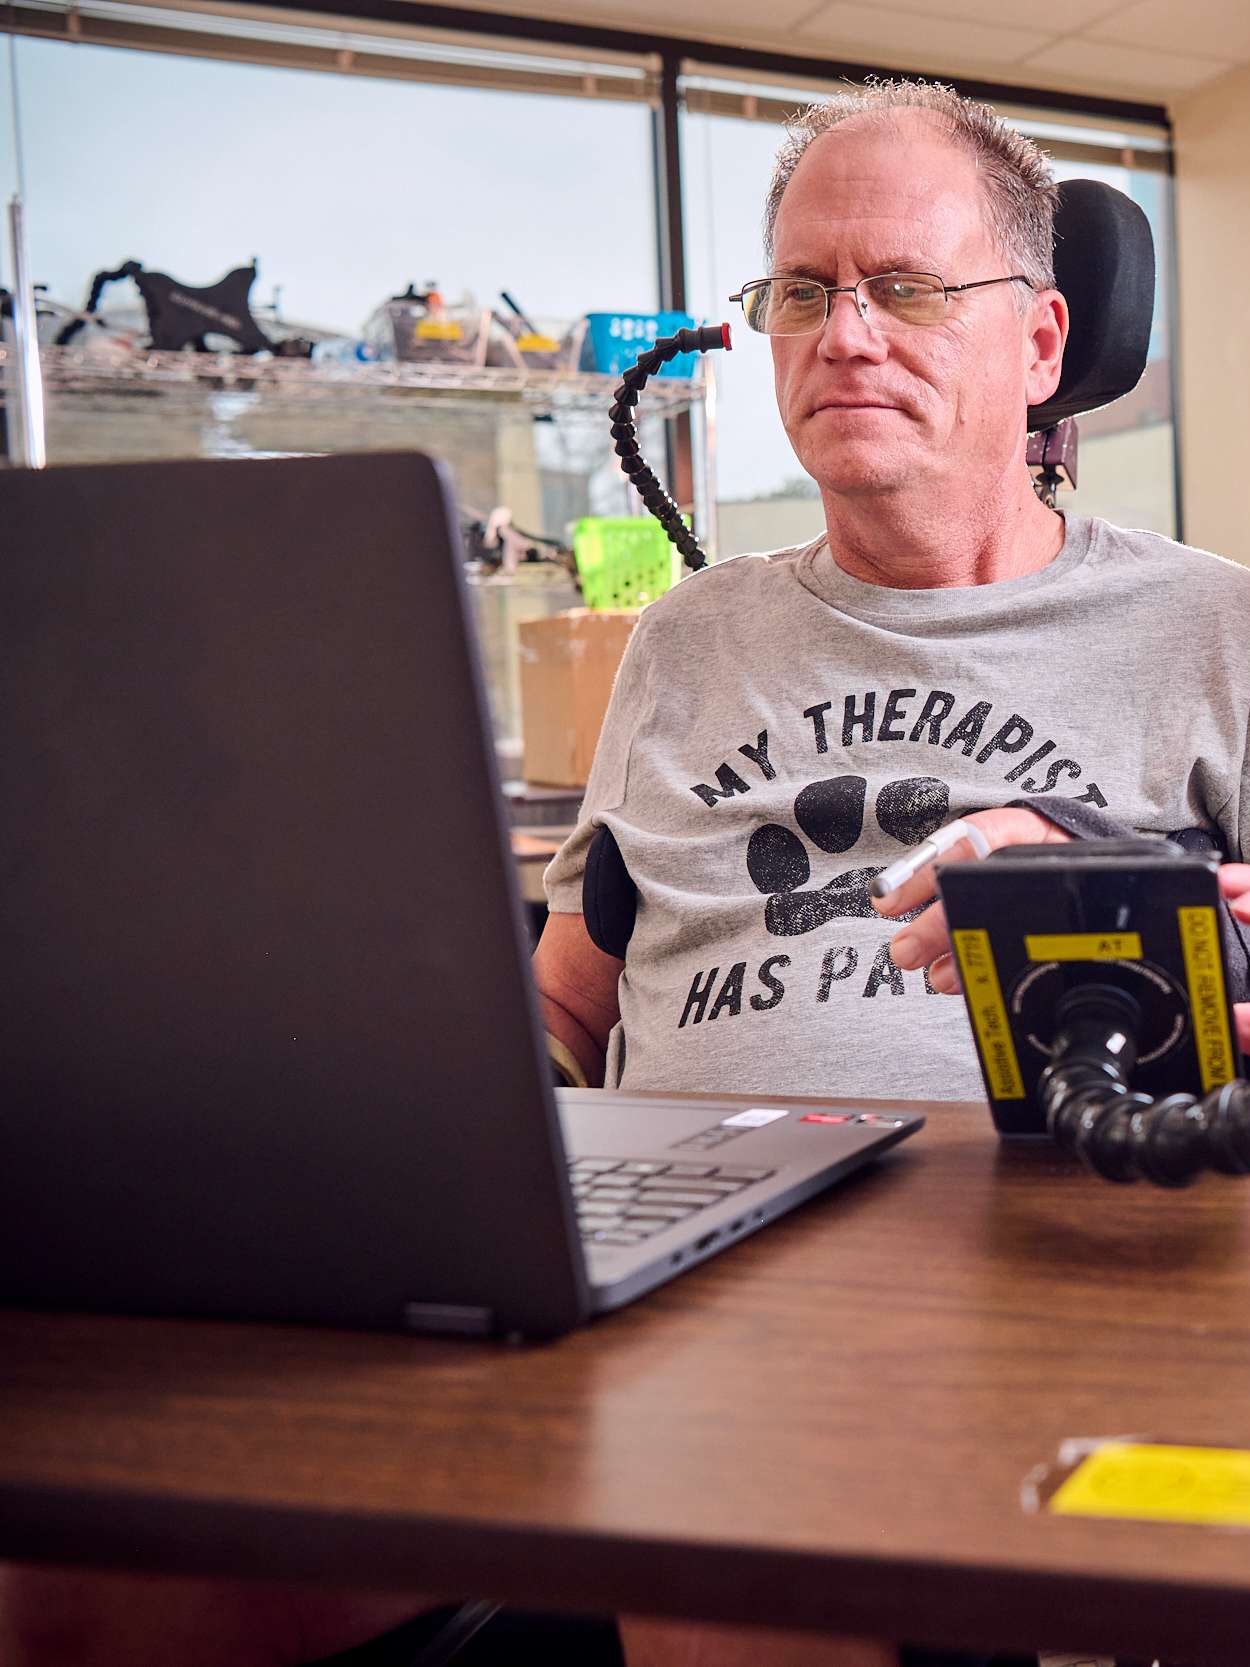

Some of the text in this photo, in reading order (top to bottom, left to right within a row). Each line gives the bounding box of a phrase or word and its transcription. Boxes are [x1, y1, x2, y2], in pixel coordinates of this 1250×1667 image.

[689, 688, 1109, 809] MY THERAPIST
[678, 954, 792, 1029] HAS
[816, 941, 939, 1003] PA
